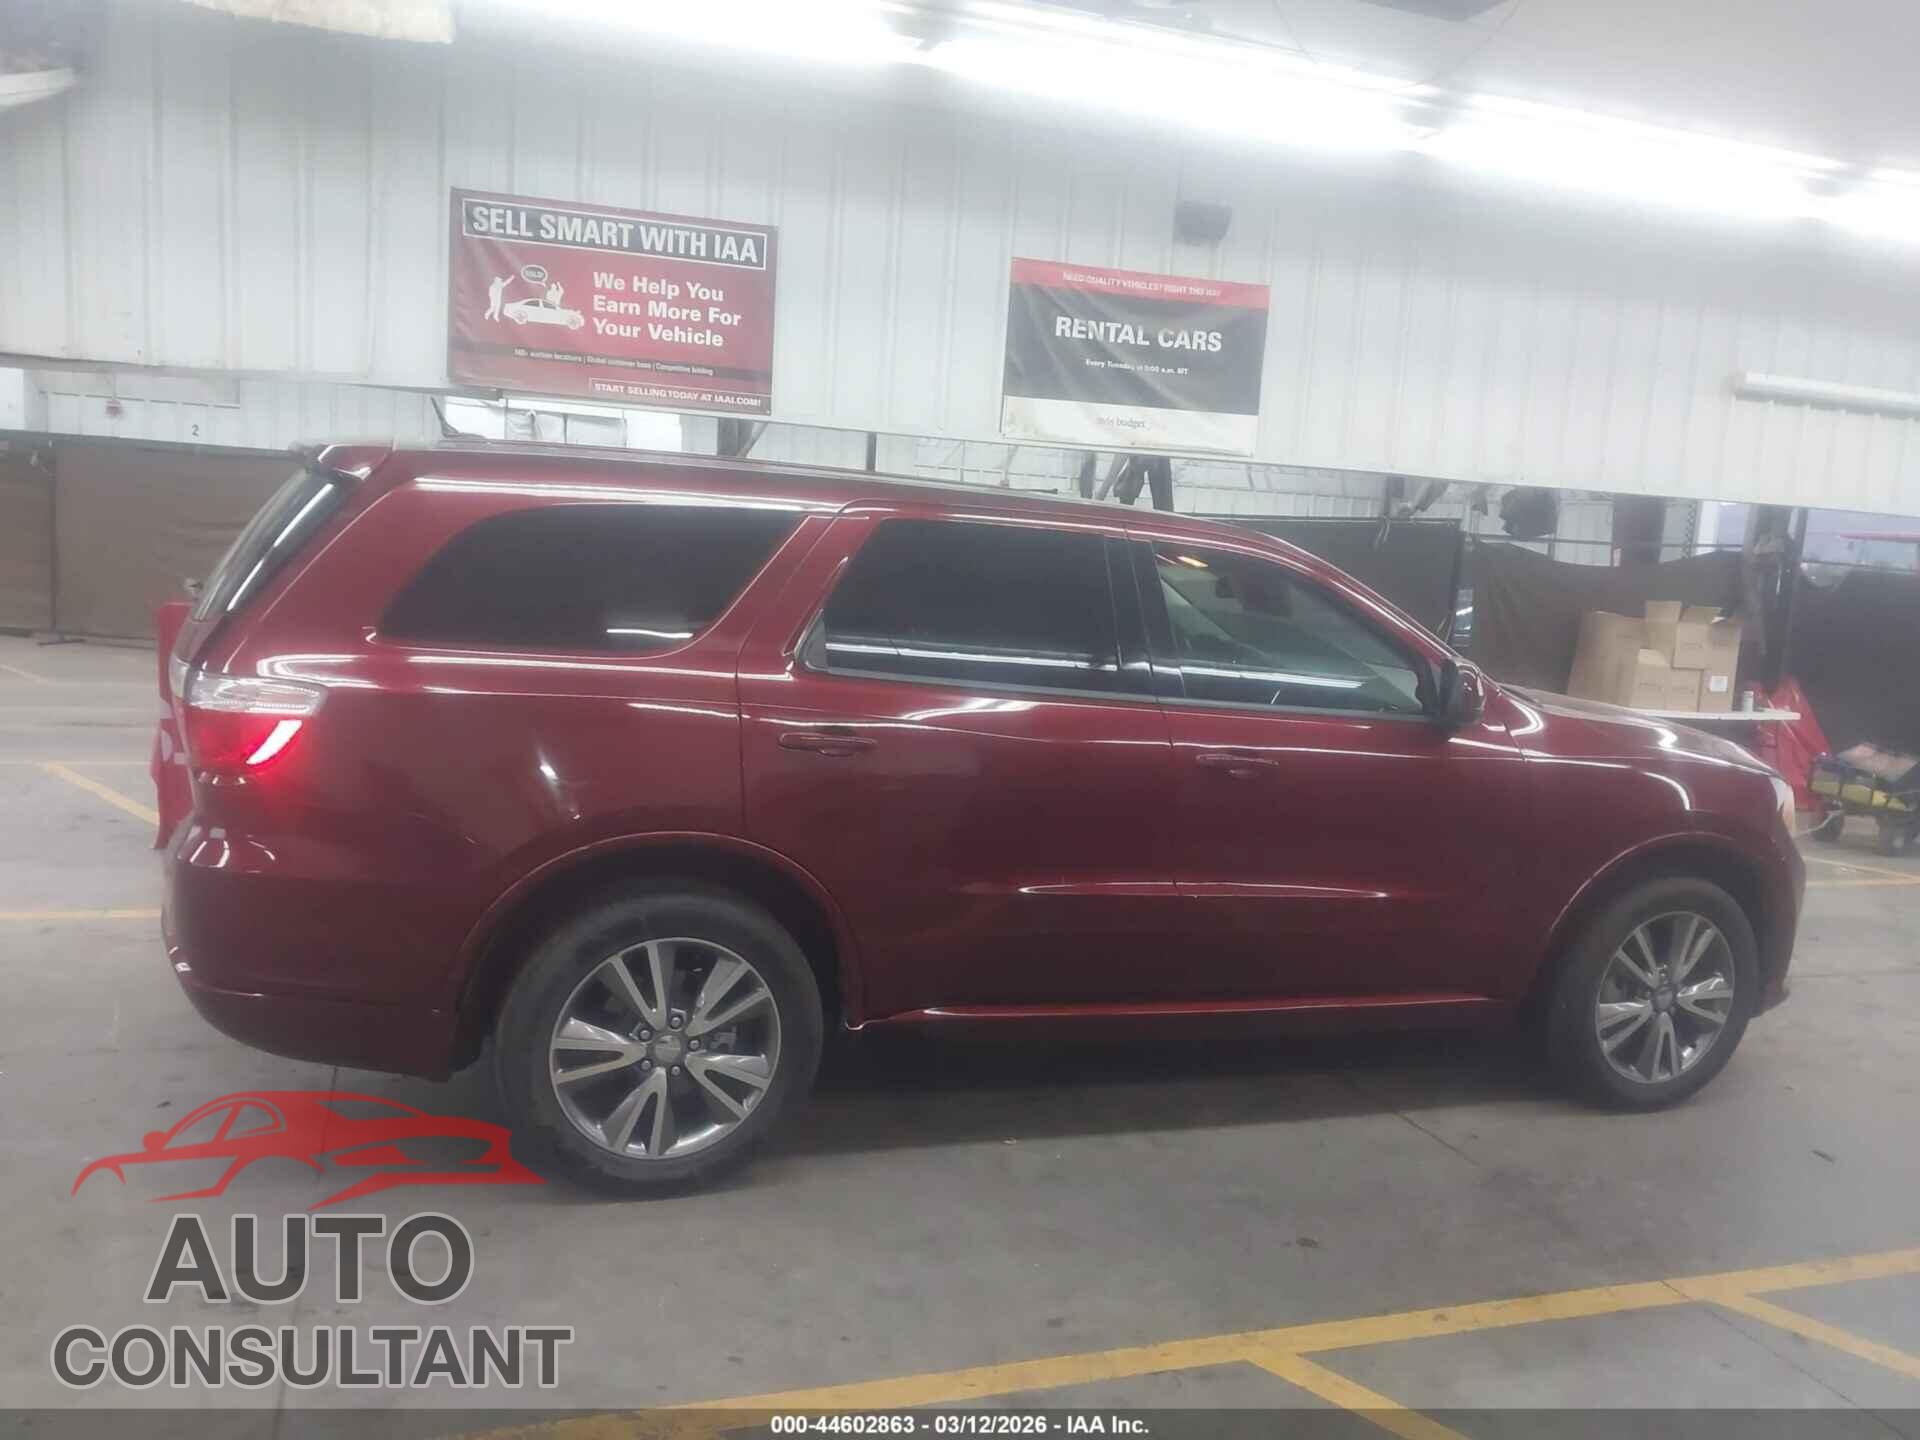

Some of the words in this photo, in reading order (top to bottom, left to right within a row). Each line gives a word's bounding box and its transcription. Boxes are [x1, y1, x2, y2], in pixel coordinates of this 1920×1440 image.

[472, 205, 533, 237] SELL
[540, 214, 634, 248] SMART
[639, 224, 706, 257] WITH
[714, 234, 758, 263] IAA
[592, 271, 625, 290] We
[632, 275, 680, 300] Help
[686, 281, 724, 302] You
[593, 294, 641, 315] Earn
[647, 300, 702, 322] More
[708, 307, 742, 326] For
[592, 316, 641, 338] Your
[647, 323, 724, 347] Vehicle
[1055, 315, 1150, 346] RENTAL
[1158, 329, 1223, 353] CARS
[594, 383, 625, 393] START
[627, 386, 667, 398] SELLING
[668, 389, 699, 401] TODAY
[700, 393, 713, 402] AT
[191, 423, 200, 437] 2
